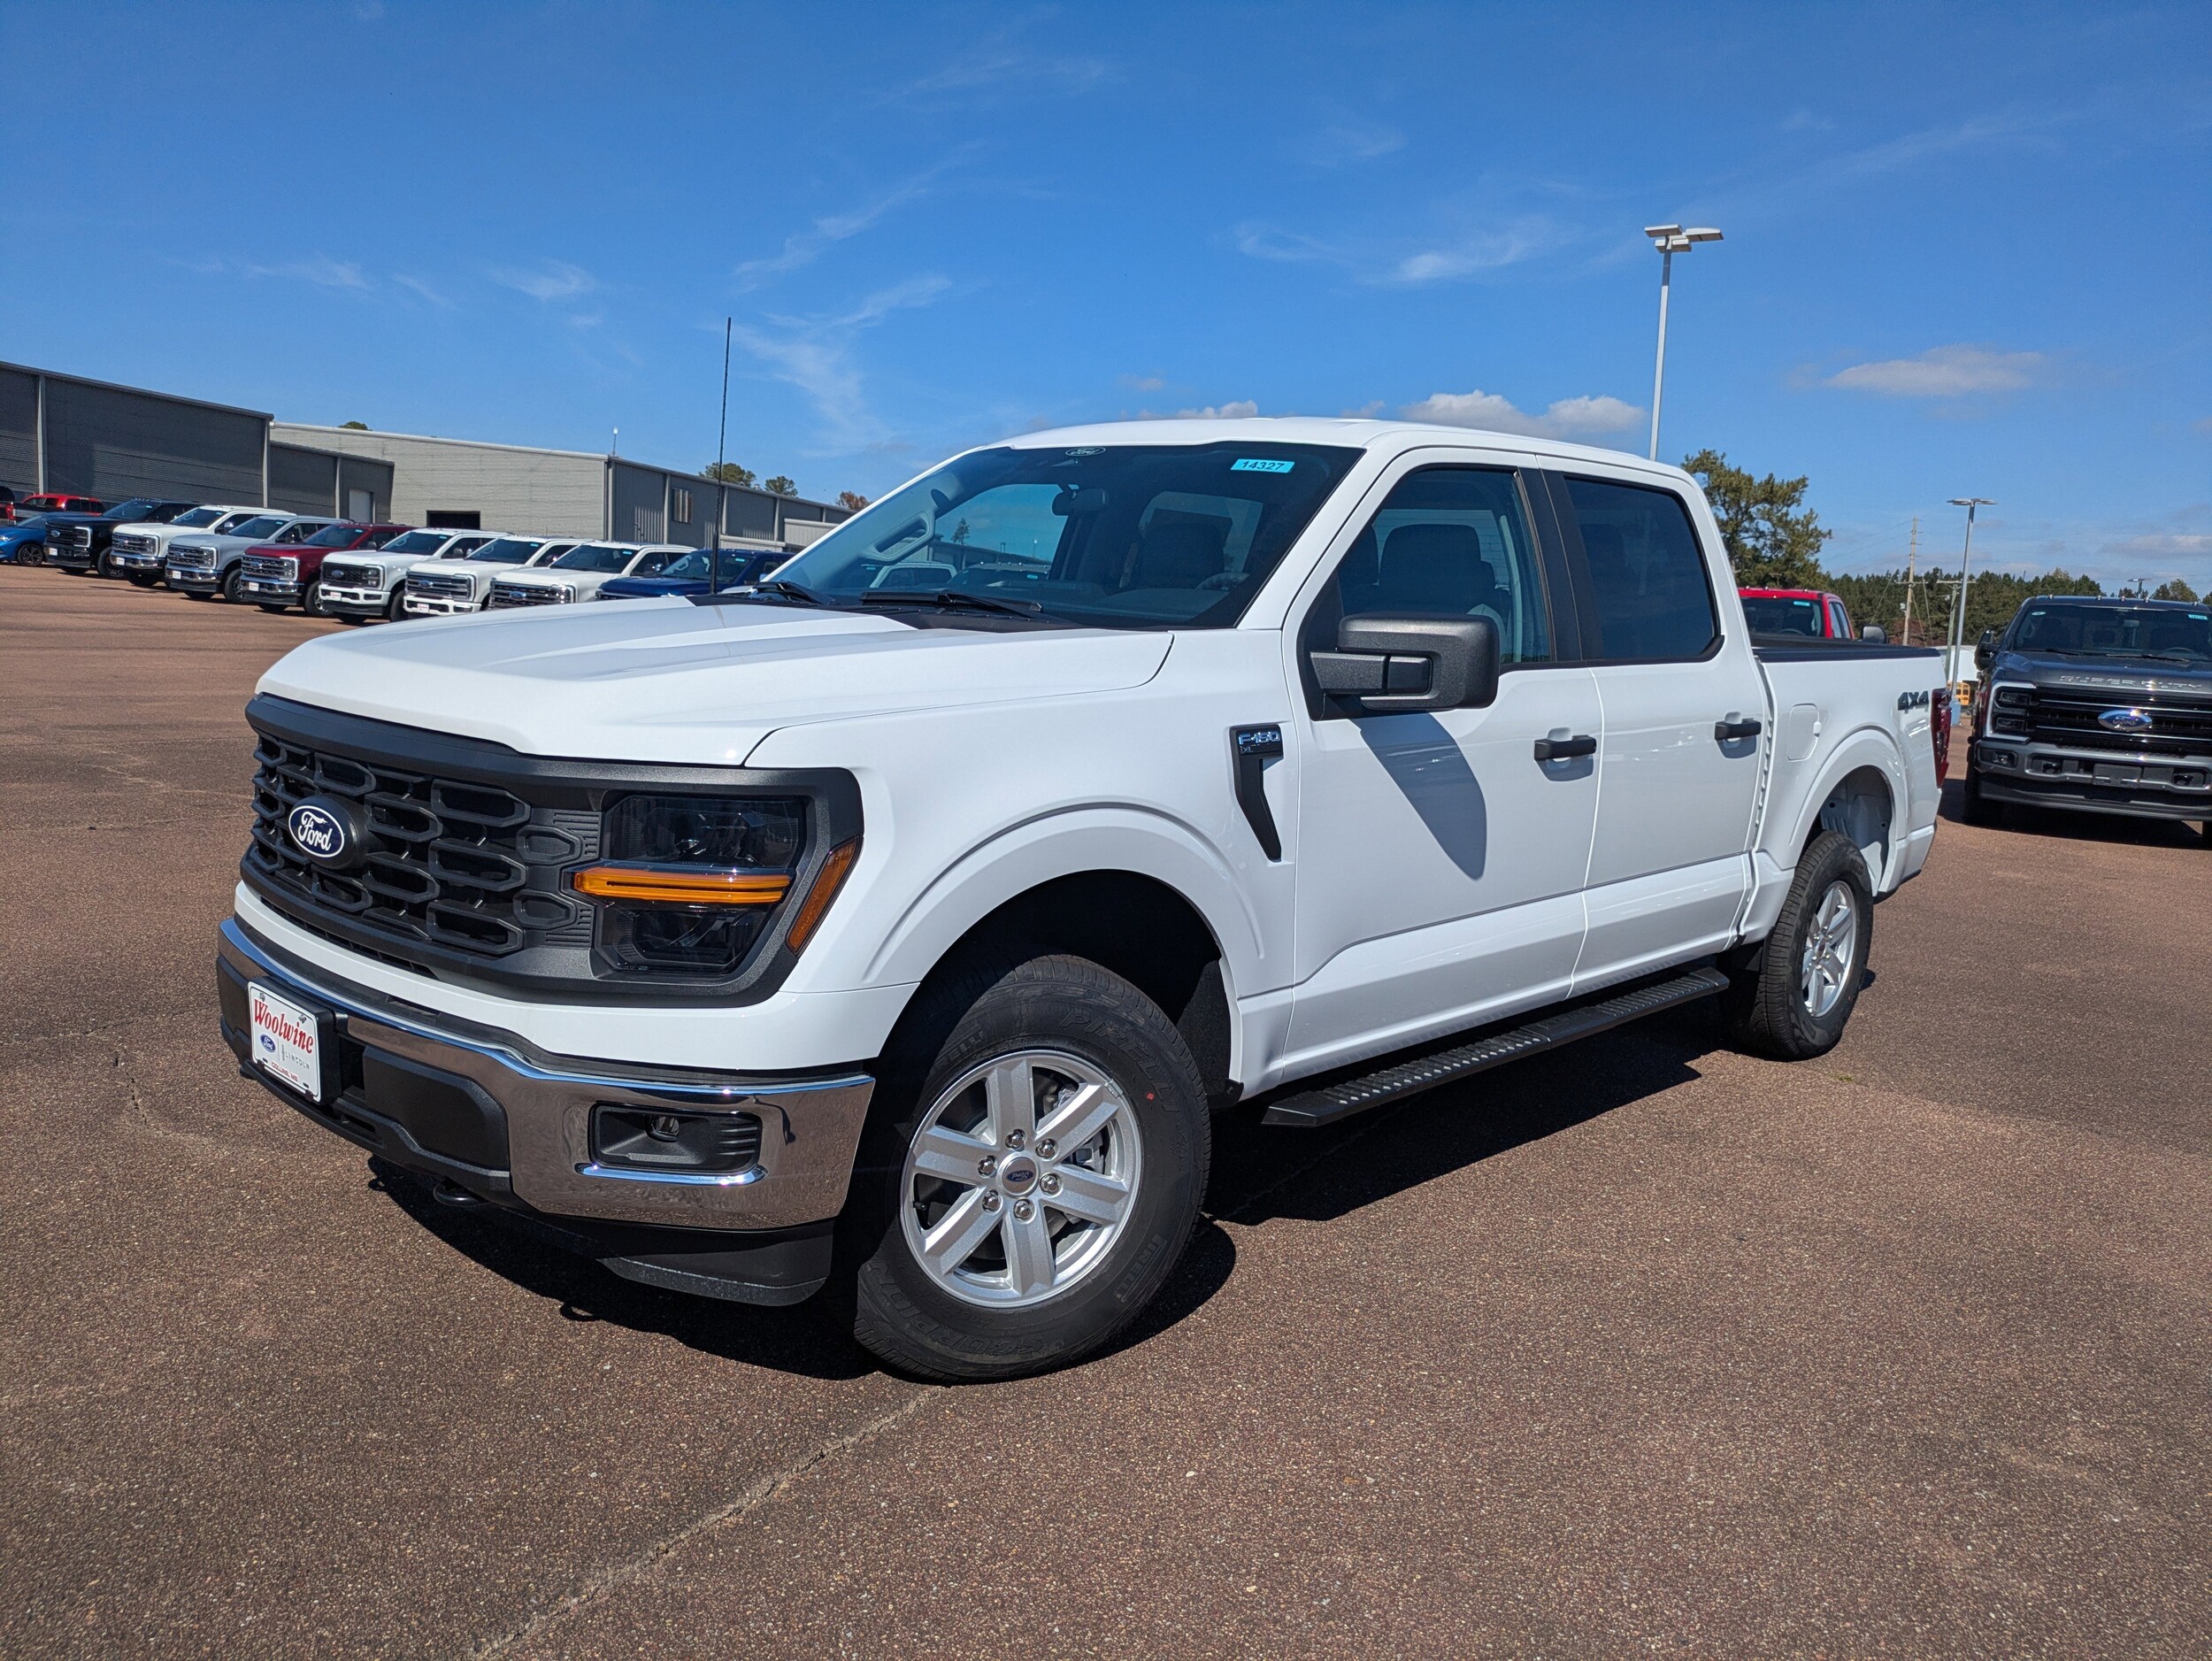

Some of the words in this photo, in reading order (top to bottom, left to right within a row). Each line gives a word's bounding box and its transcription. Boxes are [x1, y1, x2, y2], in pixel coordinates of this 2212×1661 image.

[1242, 460, 1286, 471] 14327
[1239, 731, 1280, 745] F-150
[297, 811, 334, 851] Ford
[254, 998, 314, 1054] Woolwine
[285, 1050, 310, 1070] LINCOLN
[1059, 1011, 1181, 1112] PIRELLI
